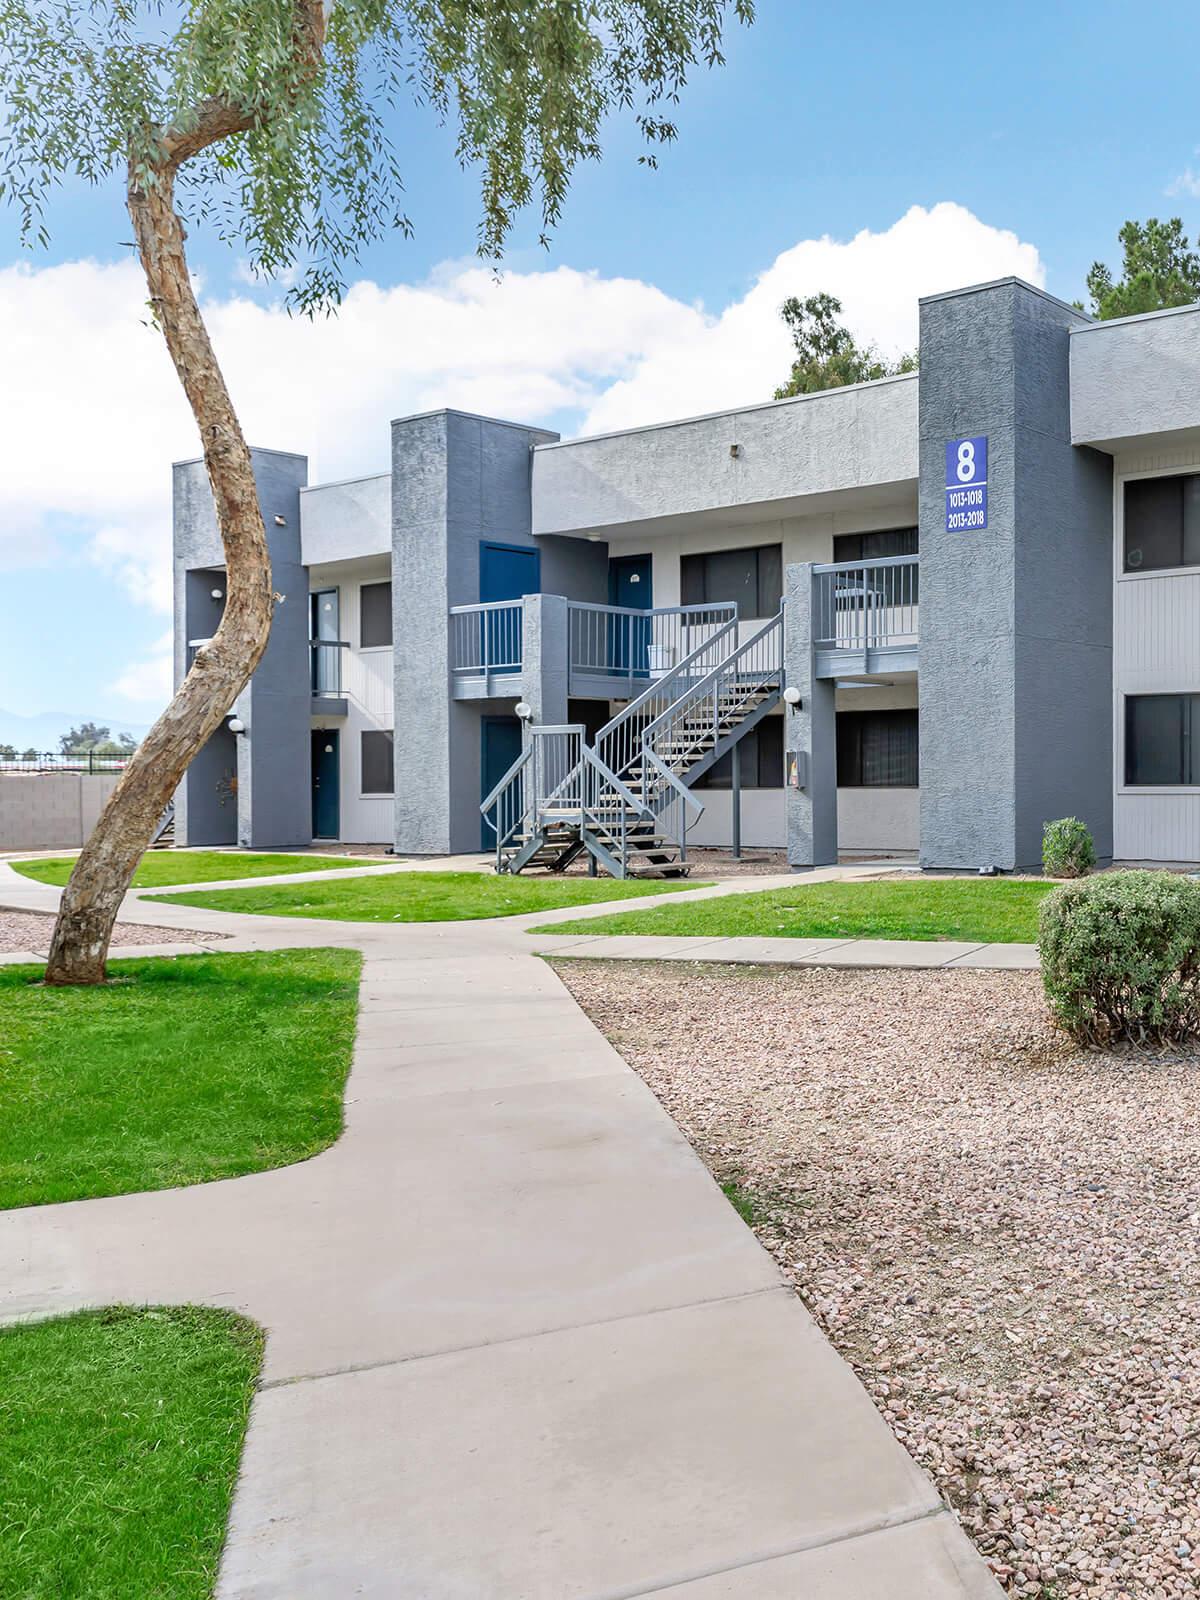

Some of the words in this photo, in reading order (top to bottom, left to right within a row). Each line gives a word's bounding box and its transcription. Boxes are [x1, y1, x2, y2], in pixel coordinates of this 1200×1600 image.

[956, 441, 976, 482] 8
[949, 489, 983, 508] 1013-1018
[948, 510, 984, 528] 2013-2018
